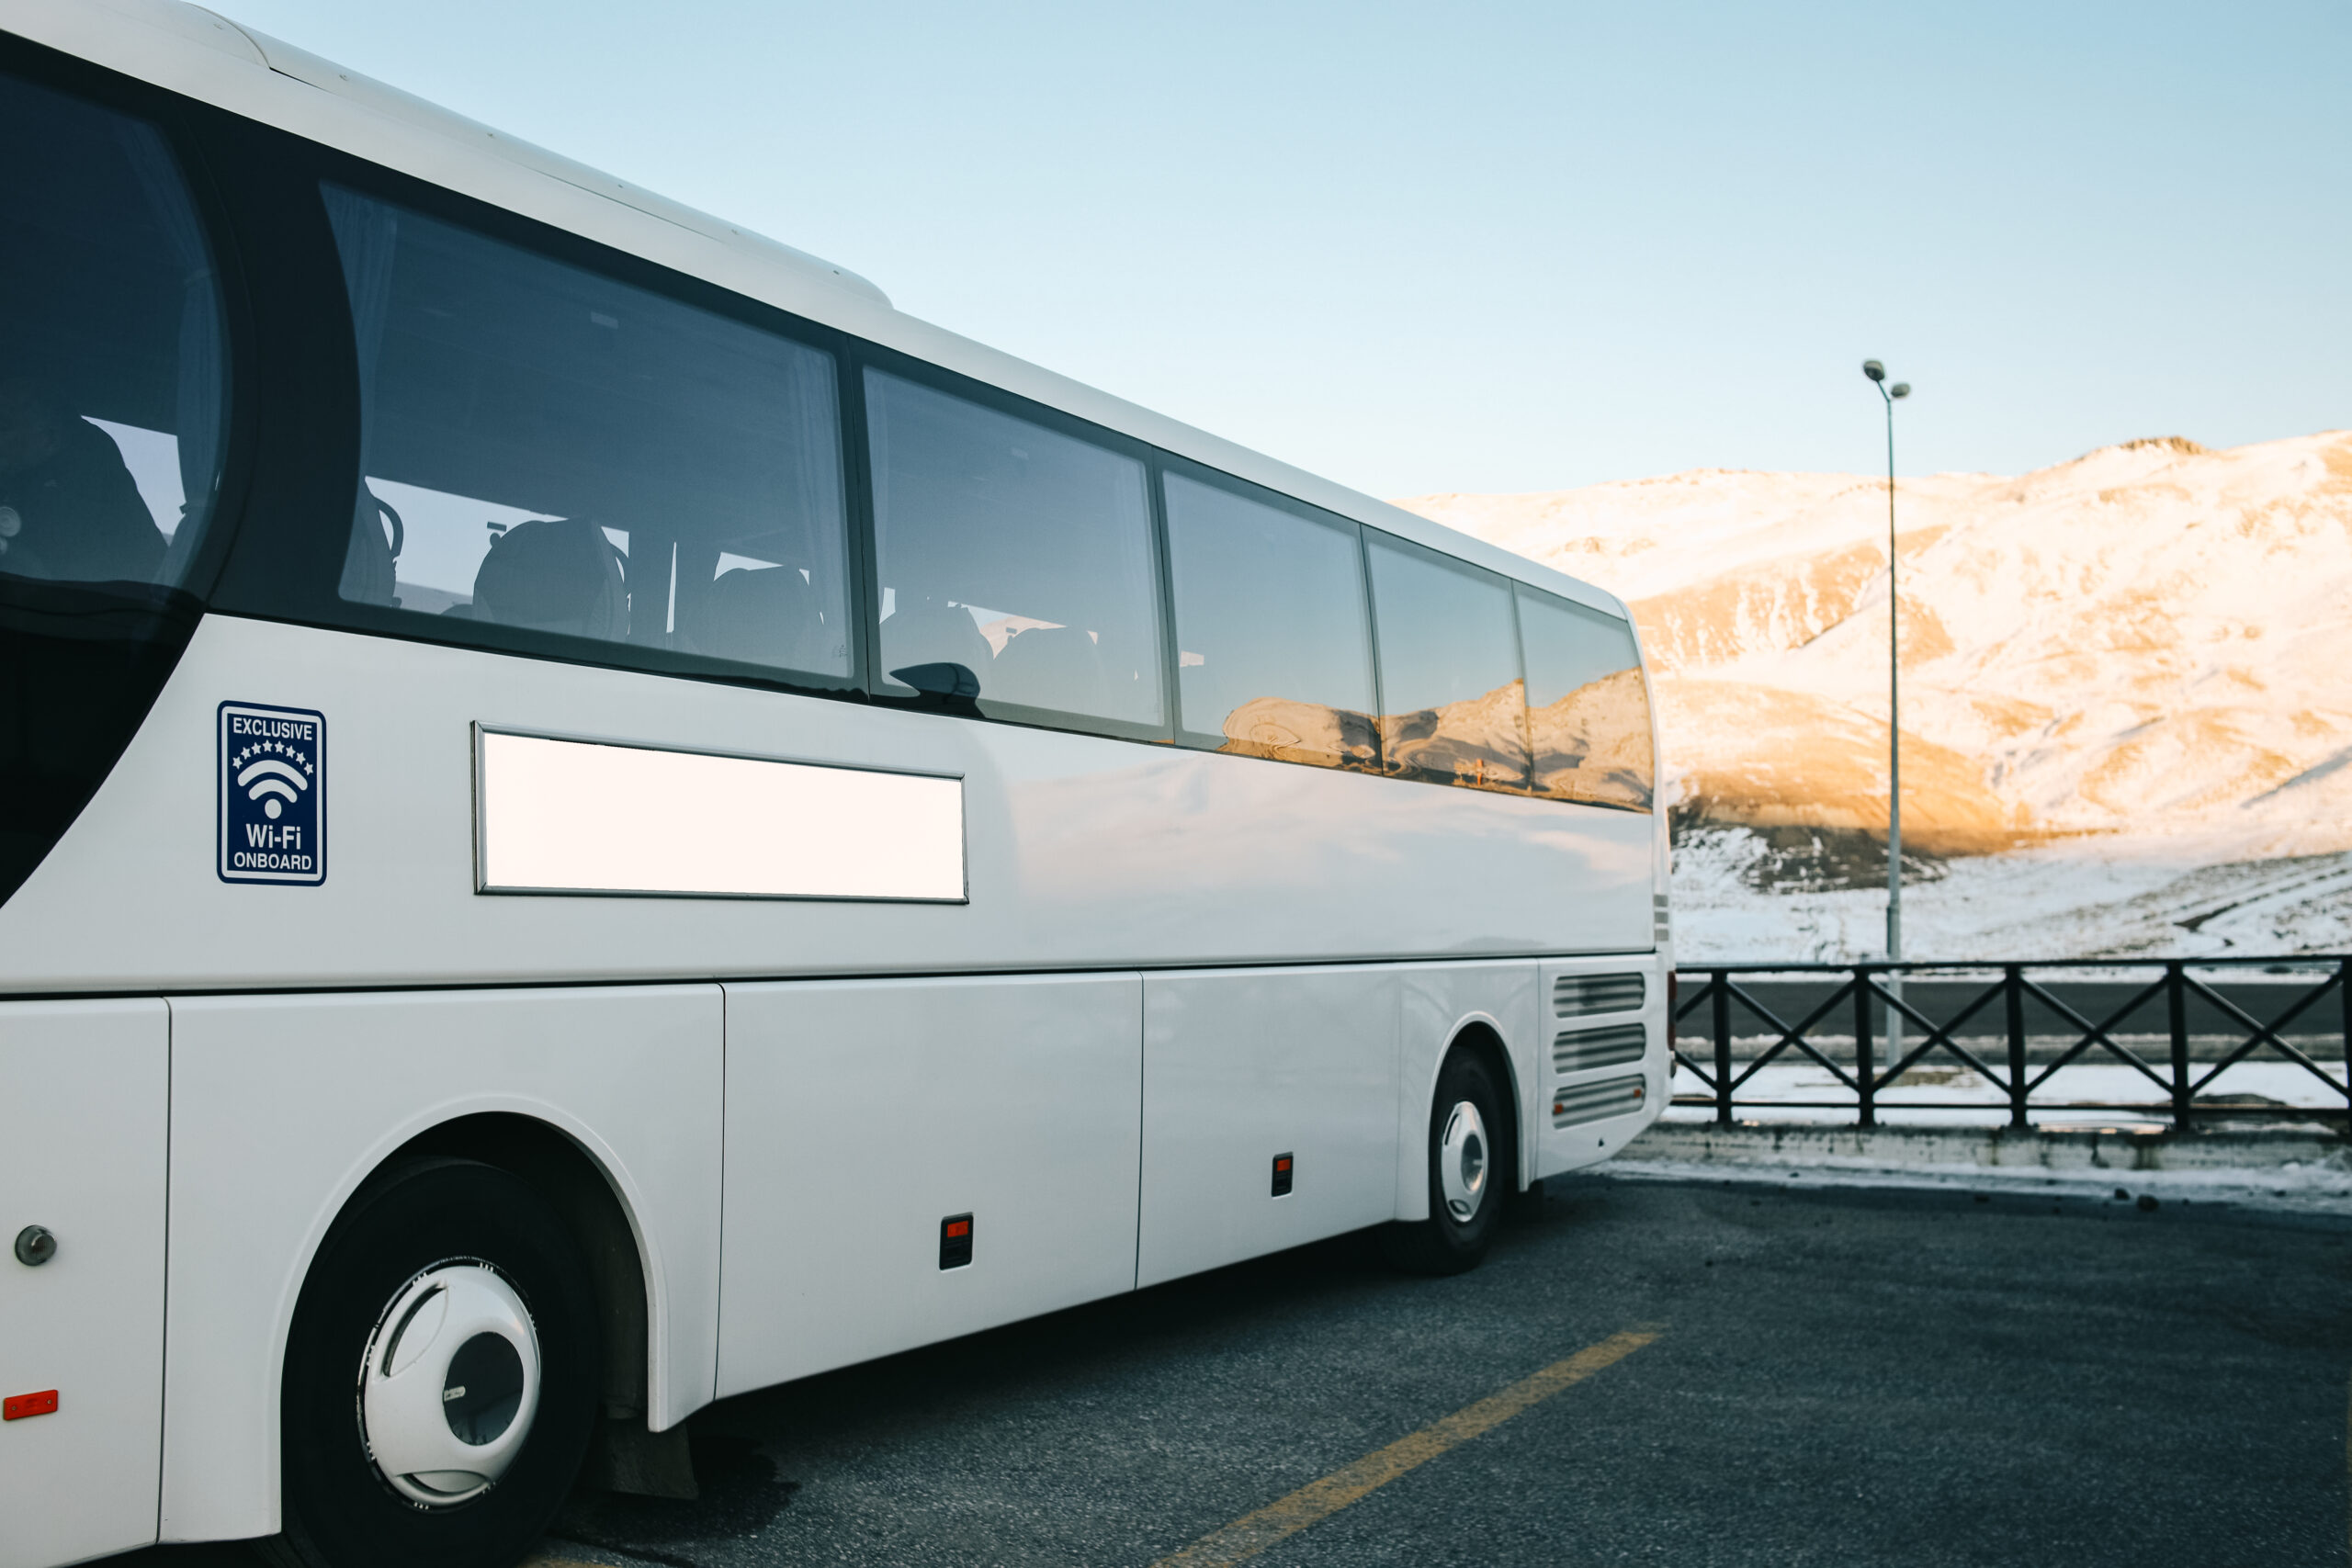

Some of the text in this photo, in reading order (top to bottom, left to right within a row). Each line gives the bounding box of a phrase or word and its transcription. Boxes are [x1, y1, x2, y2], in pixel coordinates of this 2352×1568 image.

[232, 717, 312, 741] EXCLUSIVE
[245, 823, 301, 850] Wi-Fi
[233, 852, 312, 870] ONBOARD
